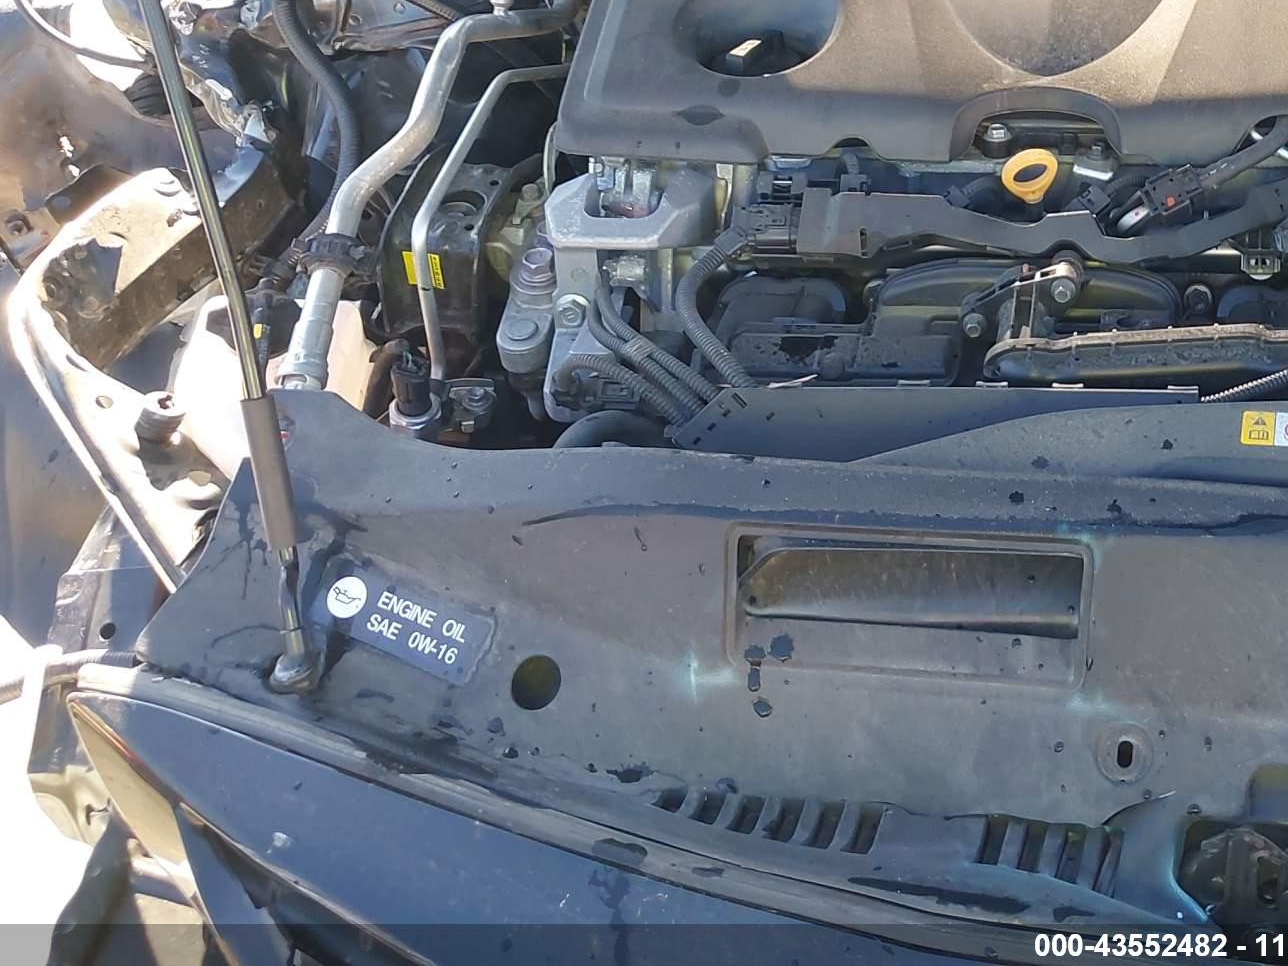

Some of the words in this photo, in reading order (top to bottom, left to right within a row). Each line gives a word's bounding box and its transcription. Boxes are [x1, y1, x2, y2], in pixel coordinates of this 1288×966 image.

[366, 613, 403, 641] SAE
[408, 631, 459, 665] 0W-16
[377, 591, 438, 629] ENGINE
[442, 619, 466, 643] OIL
